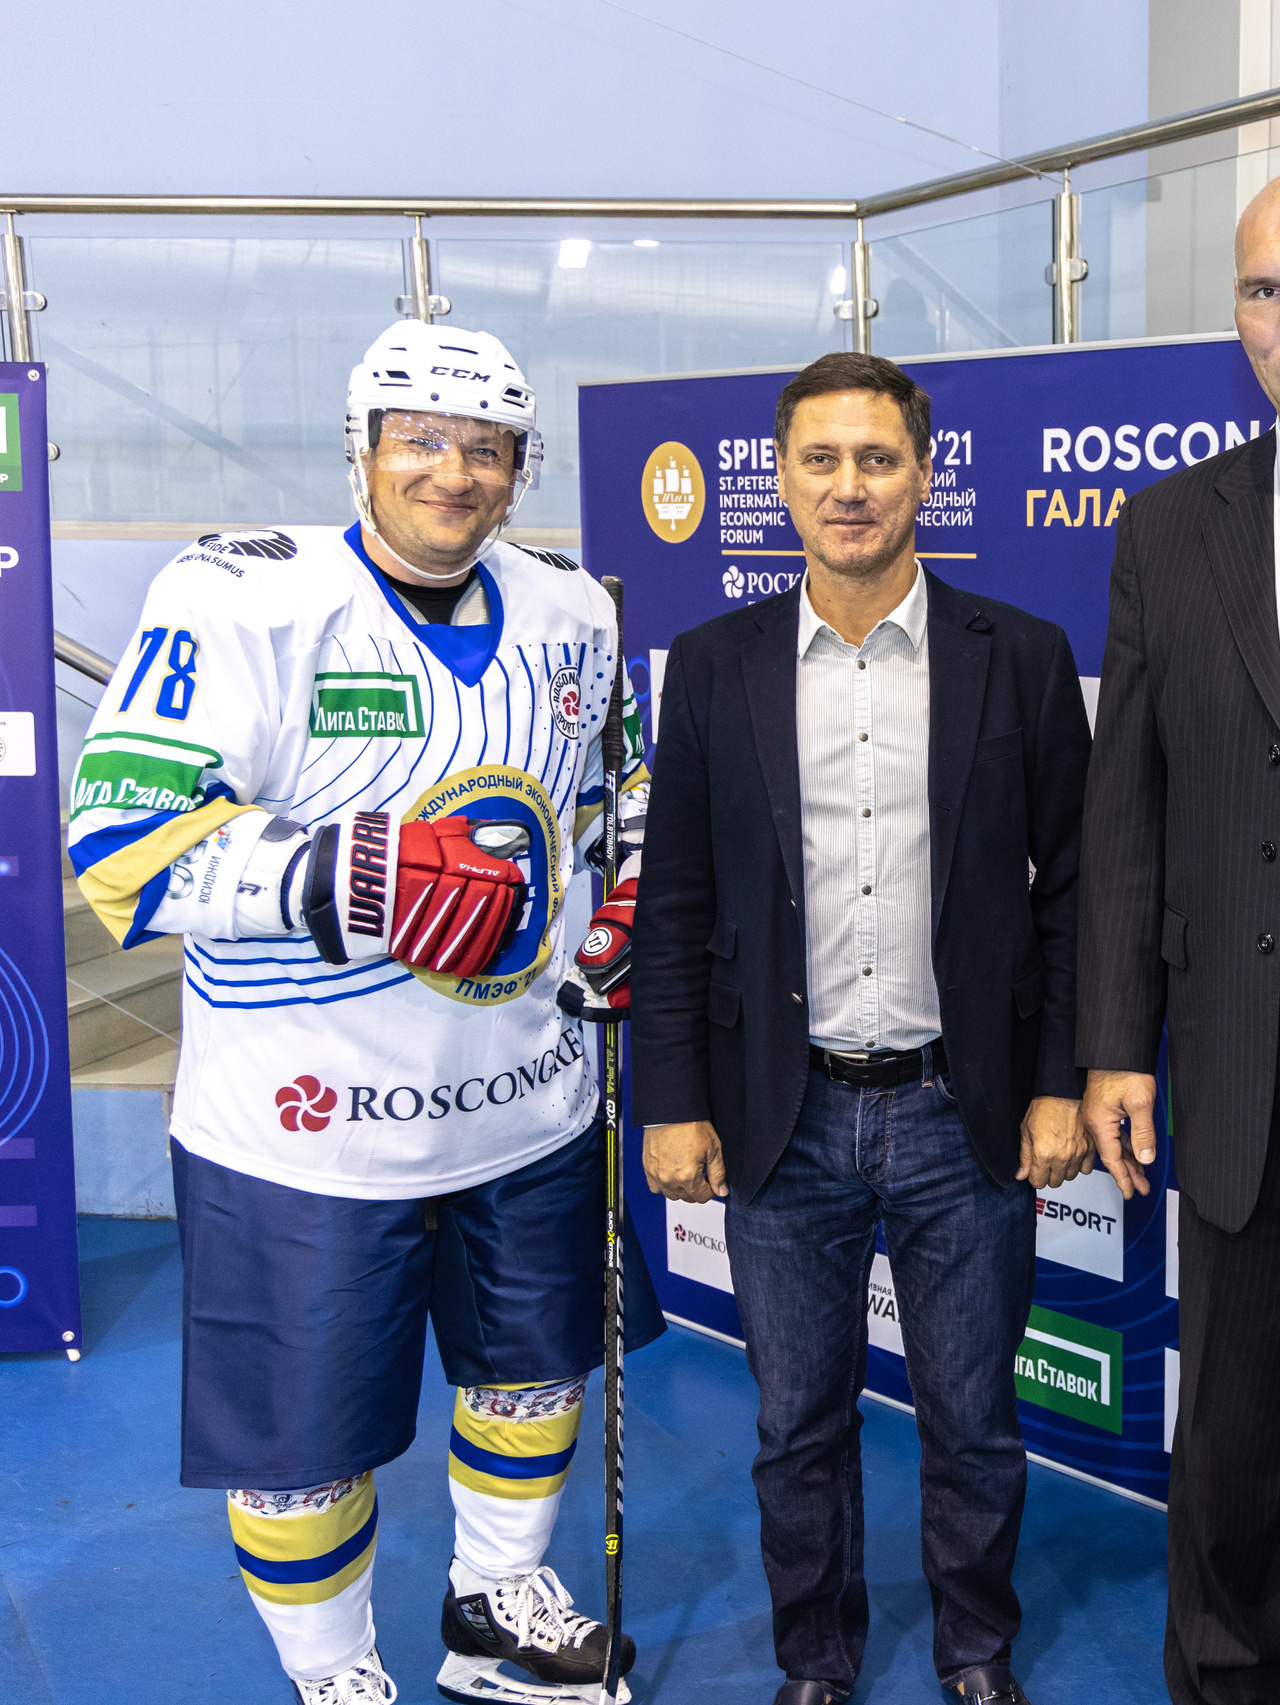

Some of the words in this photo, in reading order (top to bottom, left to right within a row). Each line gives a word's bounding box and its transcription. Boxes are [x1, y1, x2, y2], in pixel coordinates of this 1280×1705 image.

[429, 365, 492, 383] CCM
[1043, 420, 1276, 473] ROSCON
[719, 476, 735, 491] ST.
[720, 511, 786, 526] ECONOMIC
[720, 529, 764, 544] FORUM
[204, 541, 229, 554] FIDE
[211, 556, 245, 578] SUMUS
[115, 625, 200, 724] 78
[414, 774, 523, 822] ЖДУНАРОДНЫЙ
[525, 785, 560, 893] ЭКОНОМИЧЕСКИЙ
[198, 856, 221, 904] ЮСИДЖИ
[458, 863, 501, 877] ALPHA
[606, 1048, 615, 1094] ALPHA
